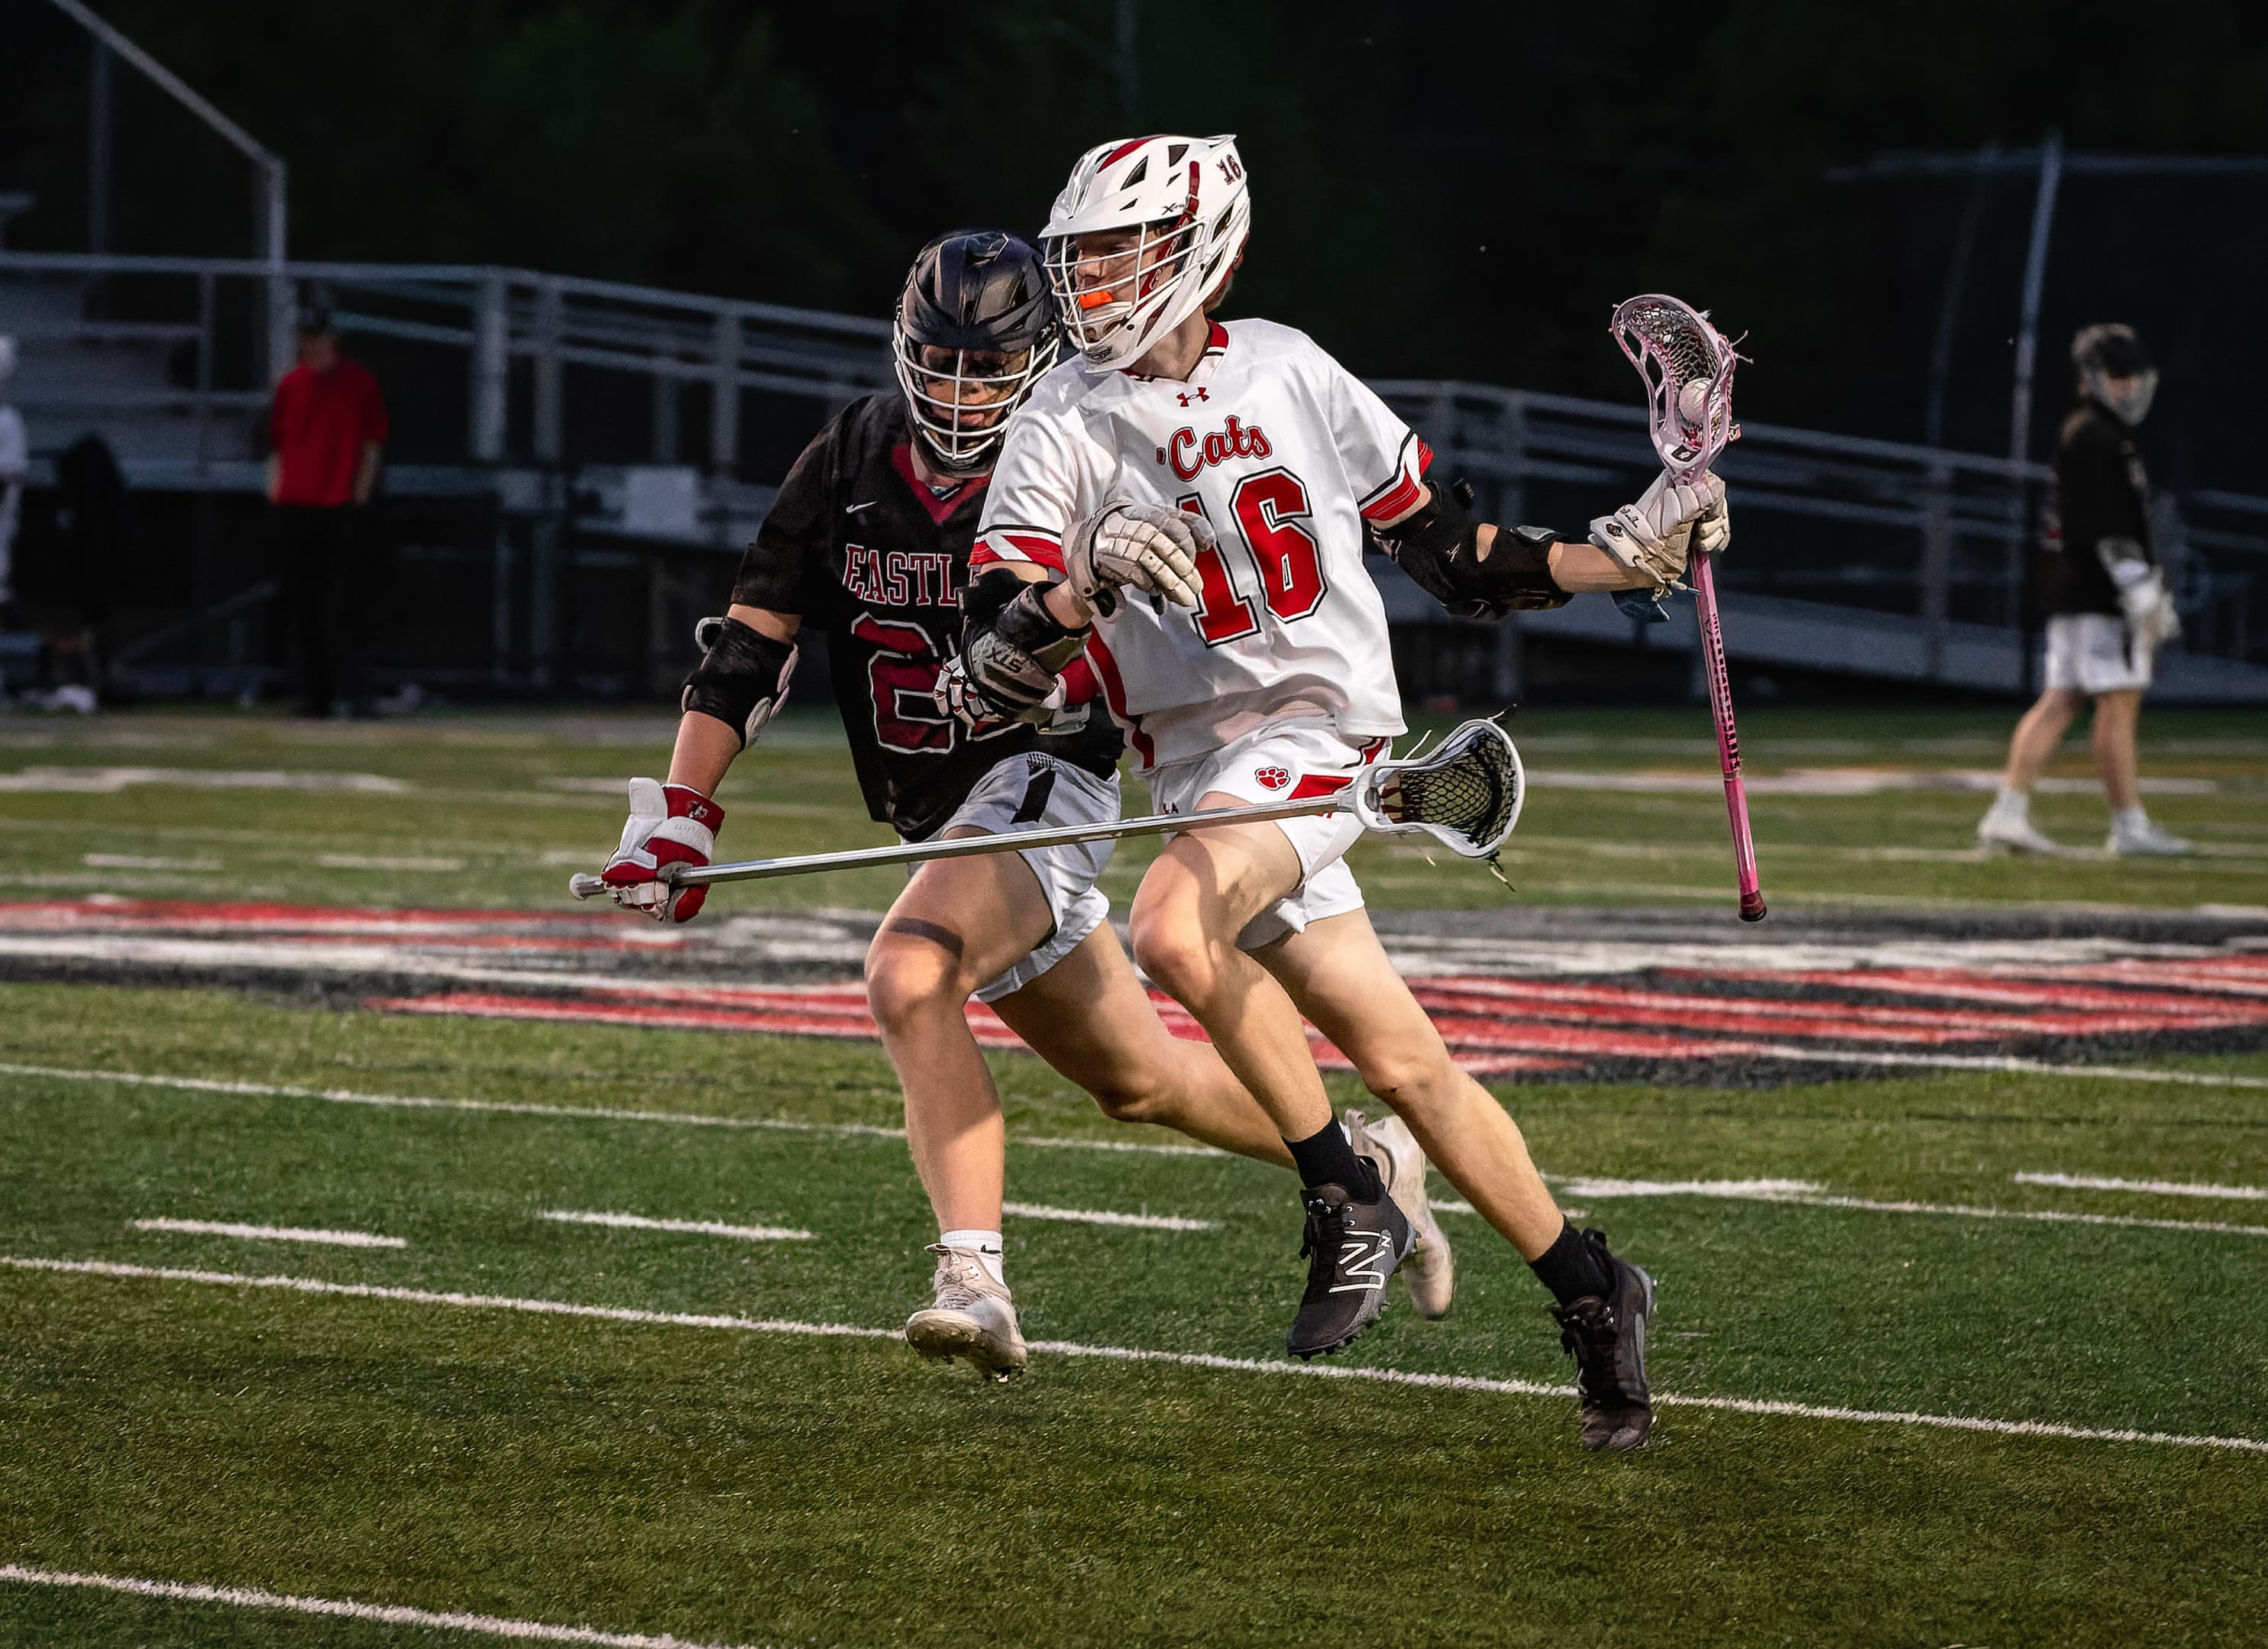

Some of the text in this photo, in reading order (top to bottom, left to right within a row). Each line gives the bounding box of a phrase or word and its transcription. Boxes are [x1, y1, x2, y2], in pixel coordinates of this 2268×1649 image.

[1216, 154, 1241, 185] 16
[842, 543, 960, 607] EASTL
[1176, 465, 1328, 649] 16
